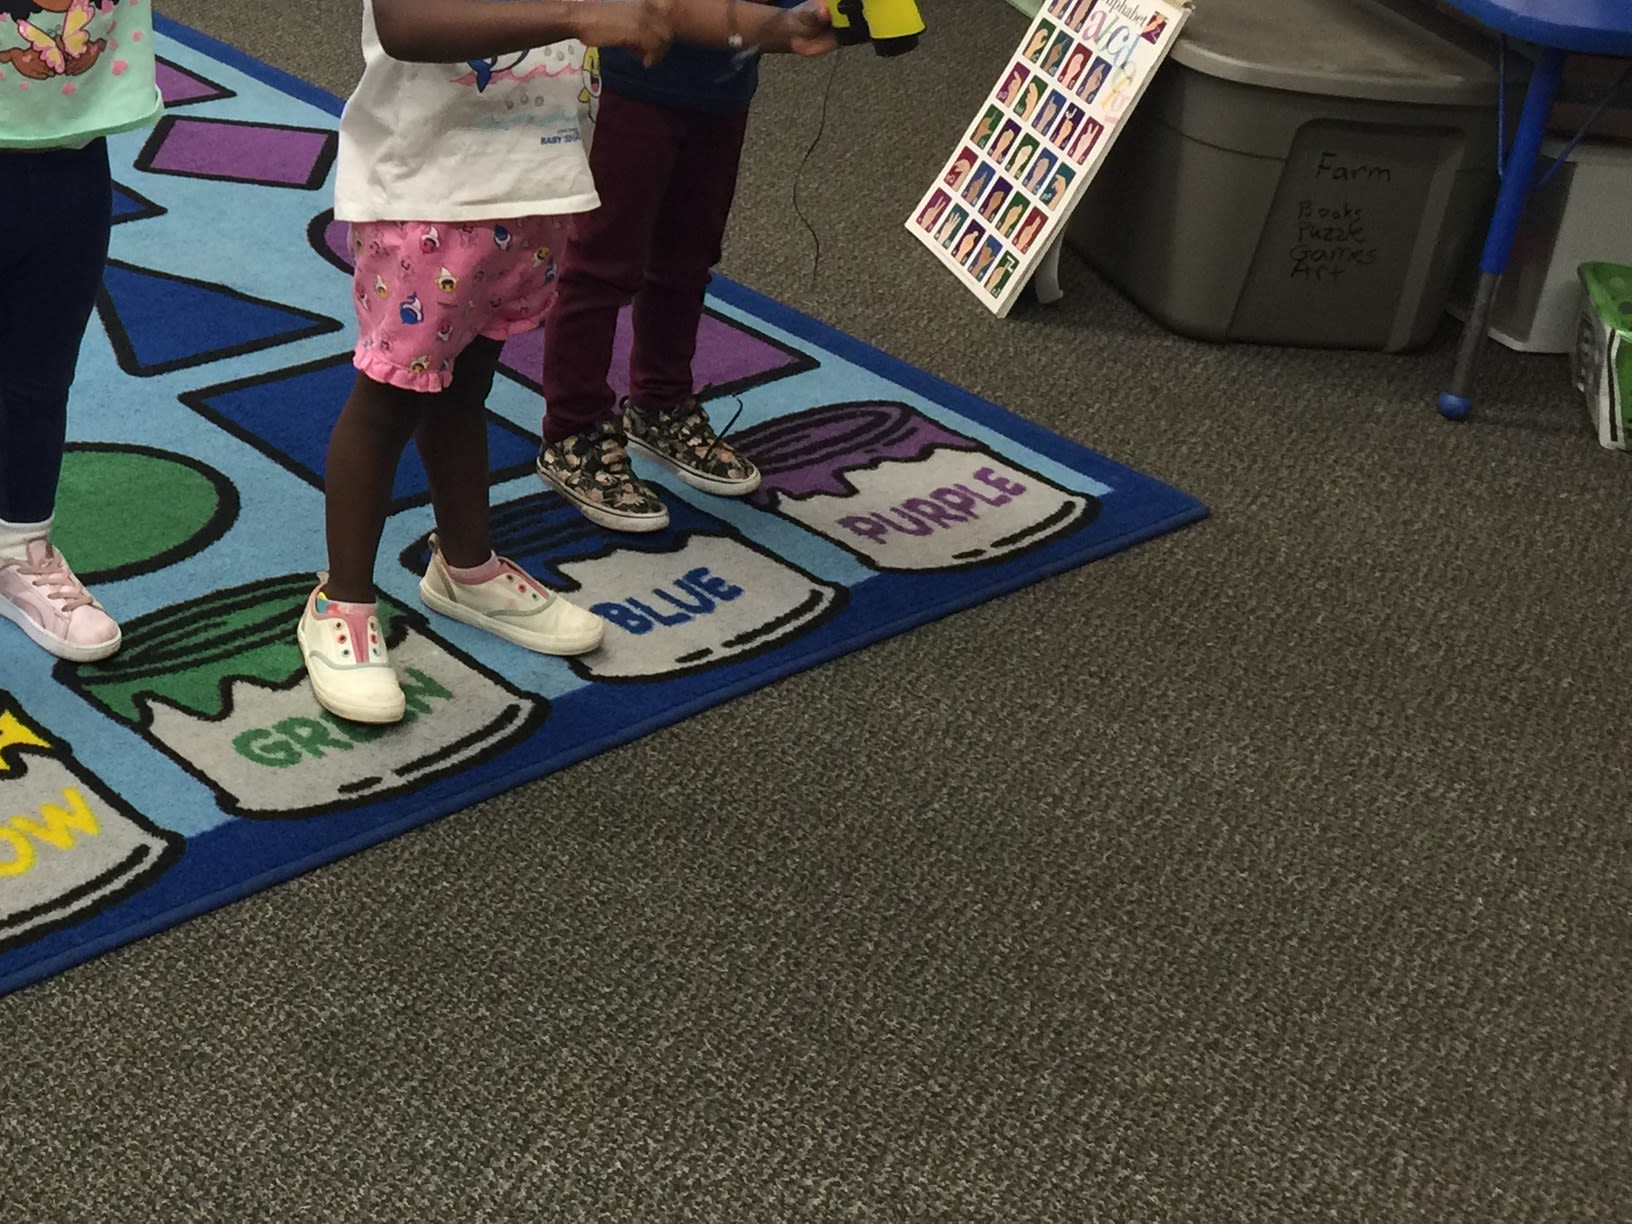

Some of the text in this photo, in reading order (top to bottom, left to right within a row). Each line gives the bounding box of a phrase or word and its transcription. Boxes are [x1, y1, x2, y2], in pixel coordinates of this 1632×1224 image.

[1315, 151, 1391, 183] Farm
[1298, 200, 1363, 221] Books
[1289, 244, 1377, 265] Games
[1290, 259, 1345, 280] Art
[835, 466, 1028, 545] PURPLE
[588, 567, 745, 636] BLUE
[232, 667, 454, 768] GRN
